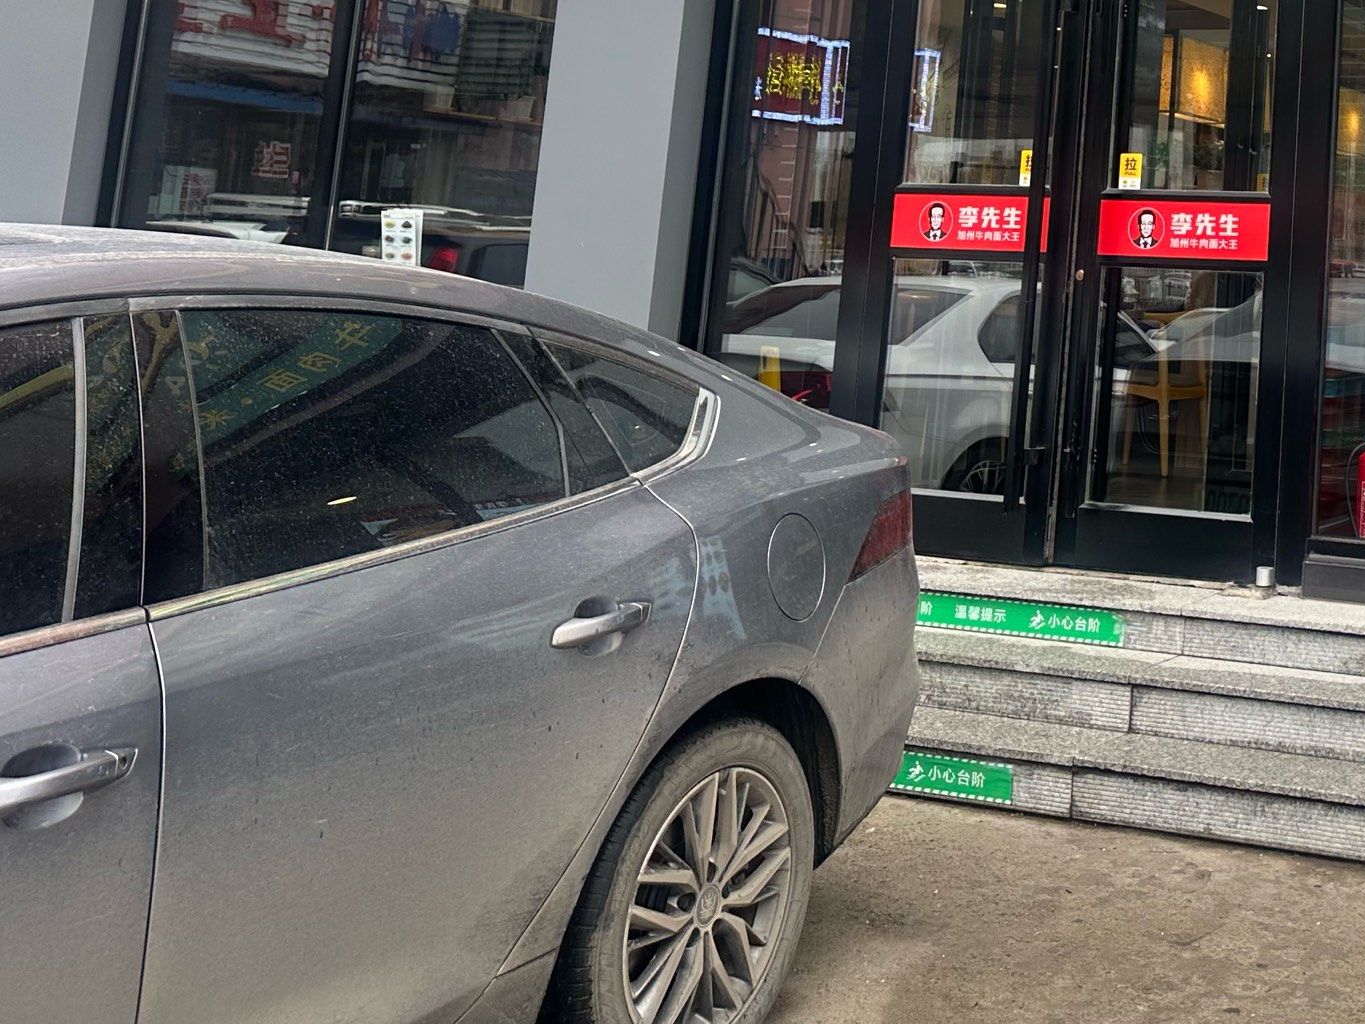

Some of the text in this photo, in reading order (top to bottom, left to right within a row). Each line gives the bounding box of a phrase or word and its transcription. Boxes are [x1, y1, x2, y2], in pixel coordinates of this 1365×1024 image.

[1124, 157, 1137, 171] 拉
[958, 206, 1022, 229] 李先生
[1170, 213, 1239, 237] 李先生
[956, 230, 1020, 242] 加州牛肉面大王
[1169, 238, 1238, 250] 加州牛肉面大王
[954, 604, 1007, 623] 温馨提示
[1047, 614, 1101, 633] 小心台阶
[927, 764, 986, 788] 小心台阶
